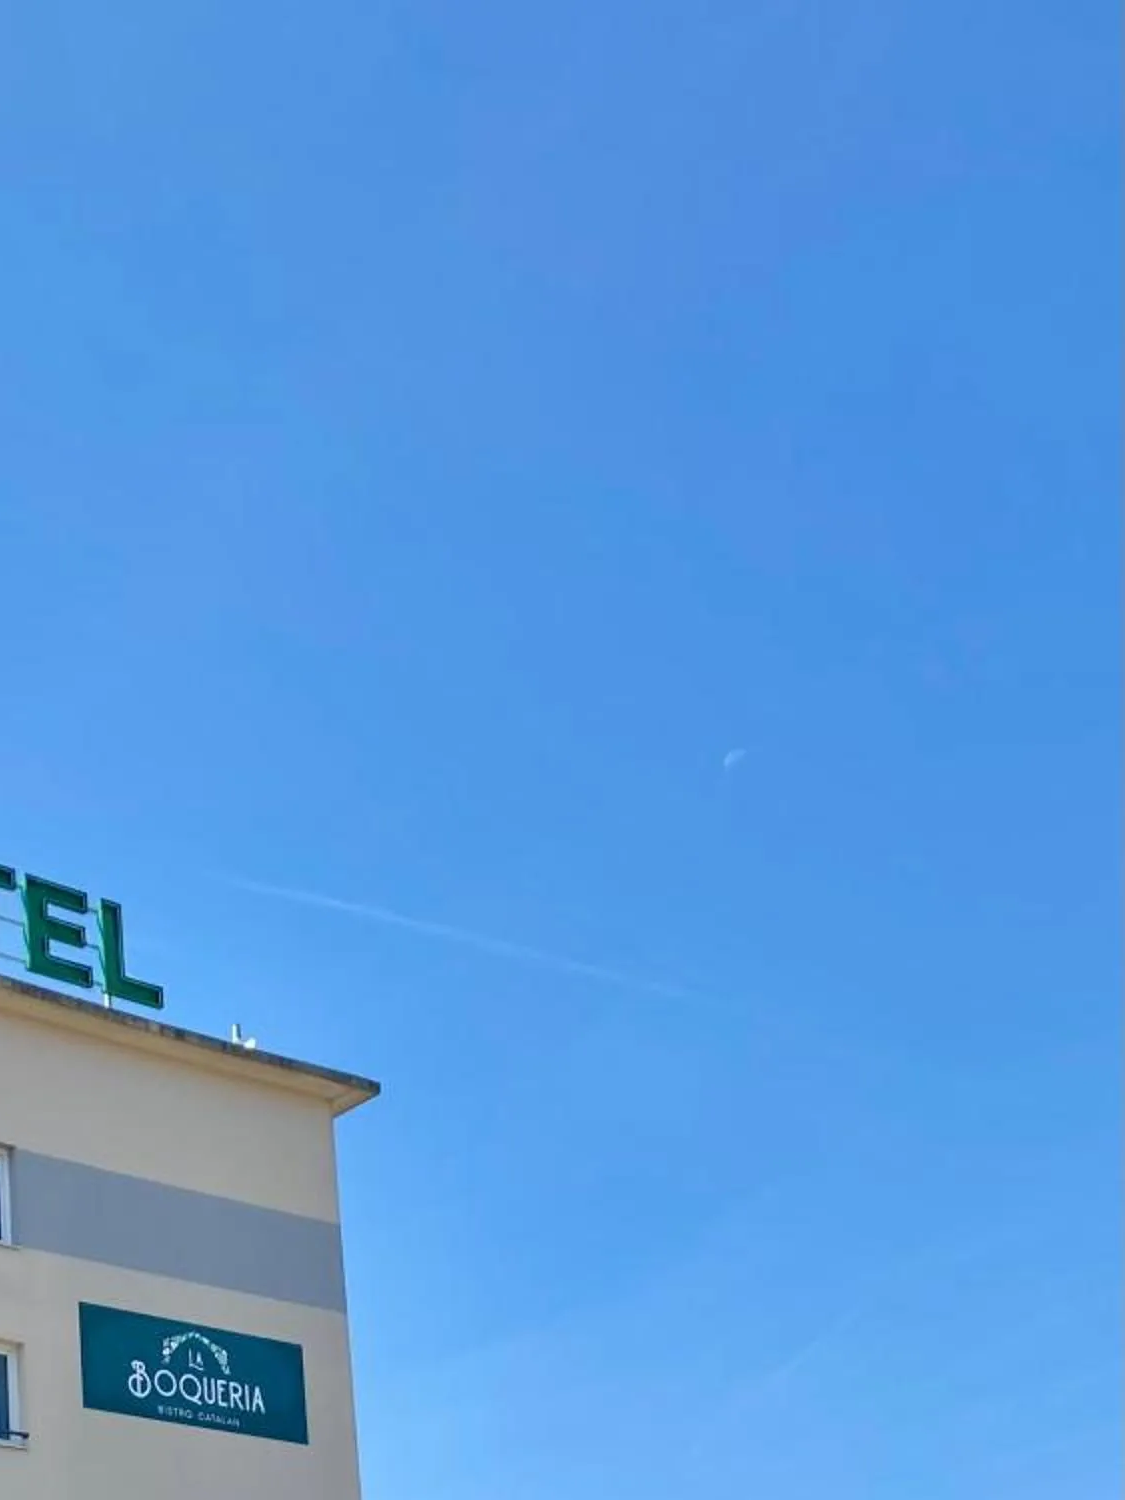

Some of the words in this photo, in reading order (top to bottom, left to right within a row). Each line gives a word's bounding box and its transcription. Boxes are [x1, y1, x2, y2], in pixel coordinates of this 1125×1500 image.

[188, 1348, 204, 1371] LA
[128, 1359, 266, 1415] BOQUERIA
[157, 1404, 193, 1419] BISTRO
